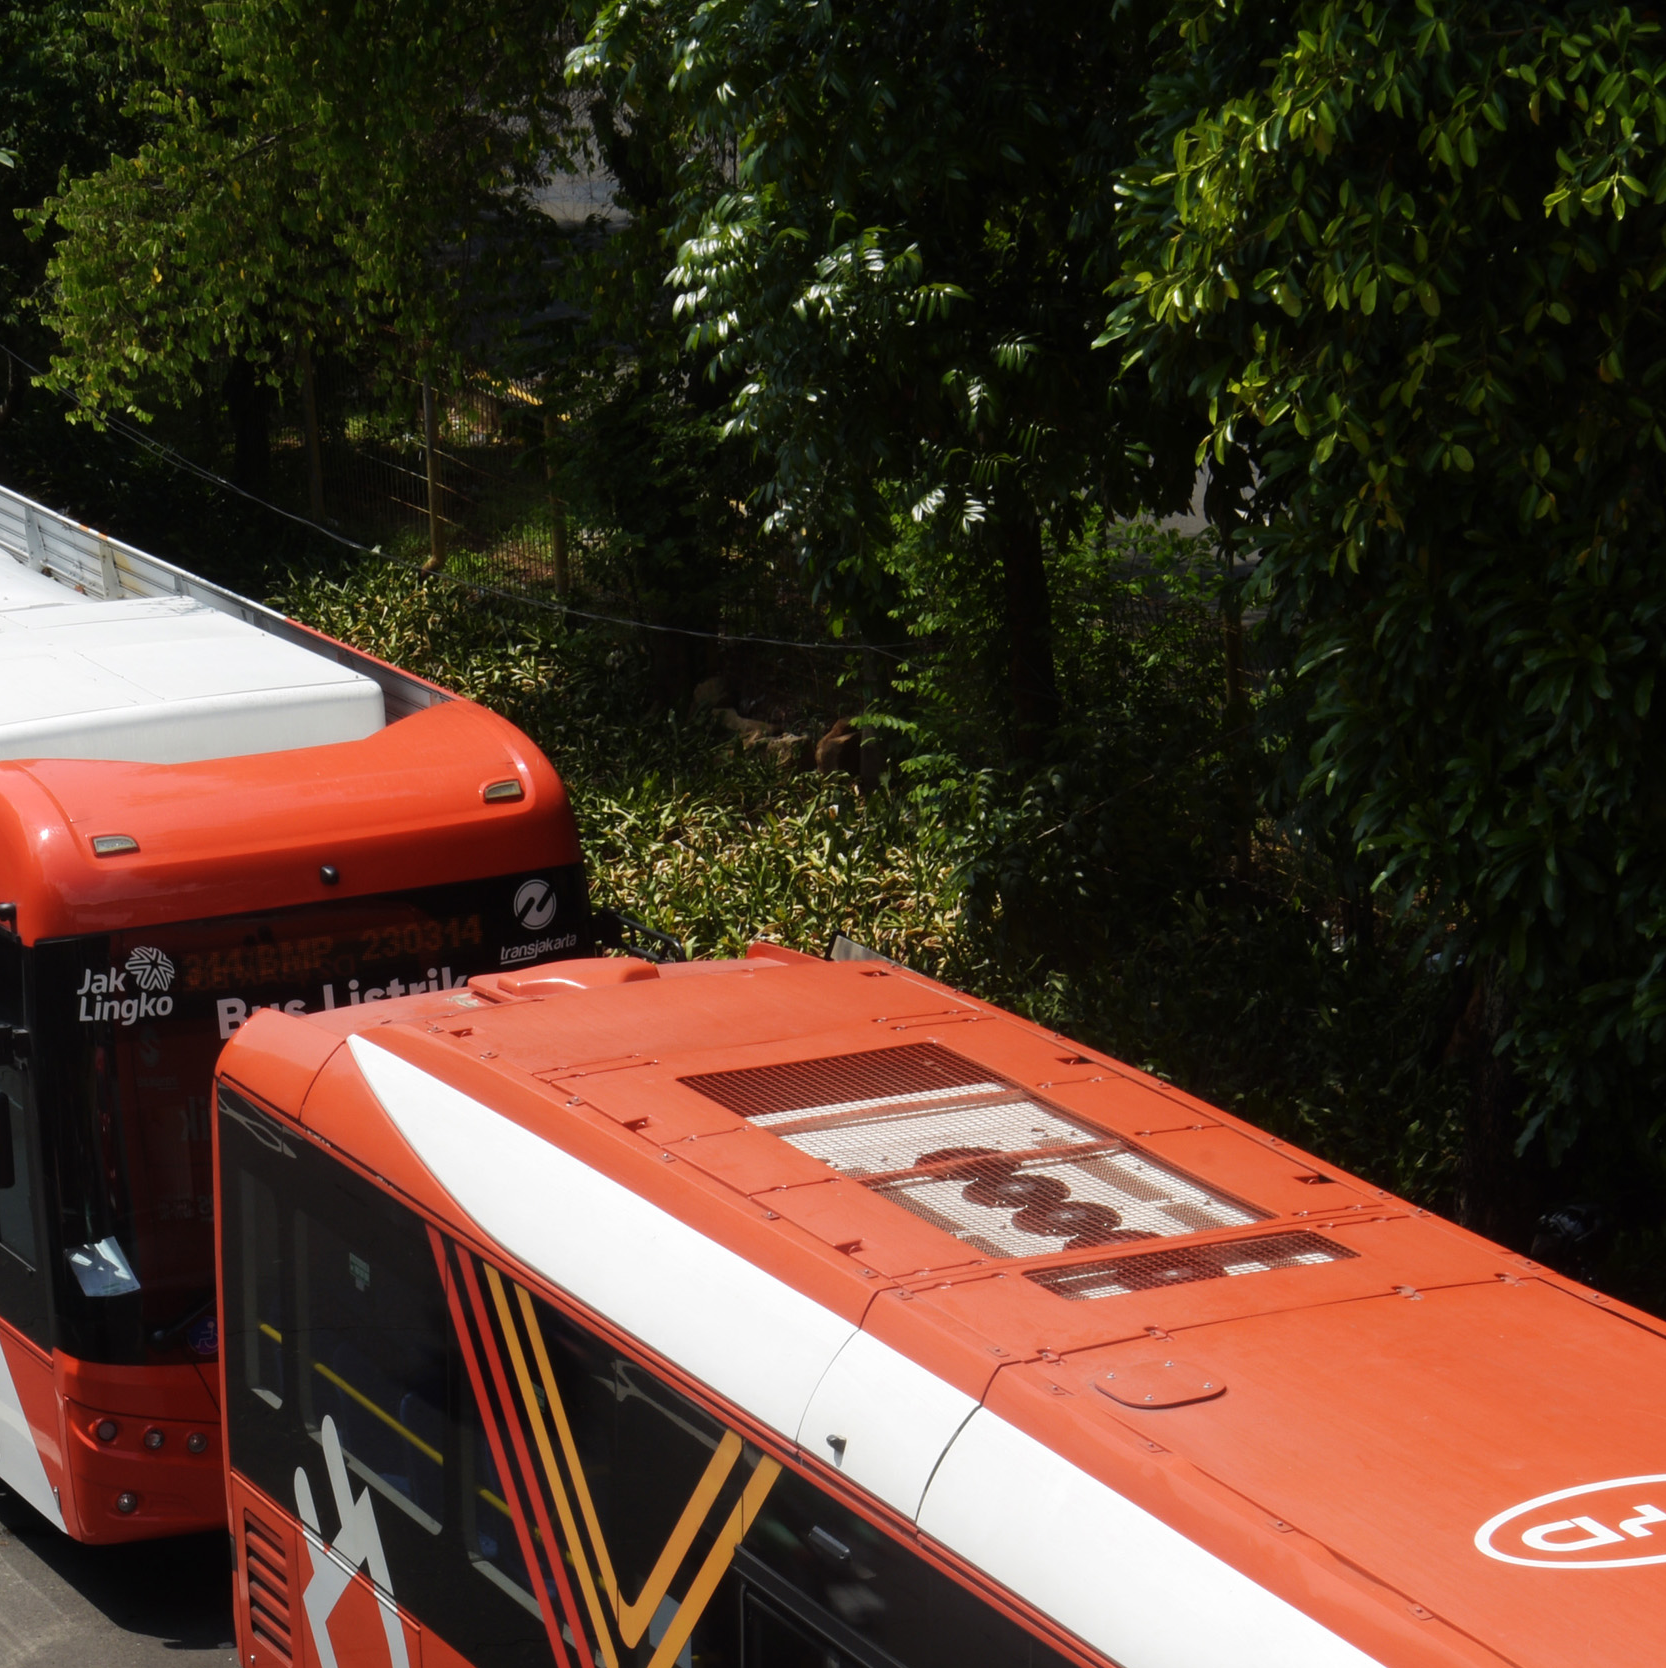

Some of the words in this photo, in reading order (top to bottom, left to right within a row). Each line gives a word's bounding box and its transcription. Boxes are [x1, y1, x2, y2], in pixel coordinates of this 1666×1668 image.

[499, 932, 577, 966] transjakarta
[76, 966, 127, 995] Jak
[78, 992, 174, 1026] Lingko
[216, 997, 307, 1040] Bs
